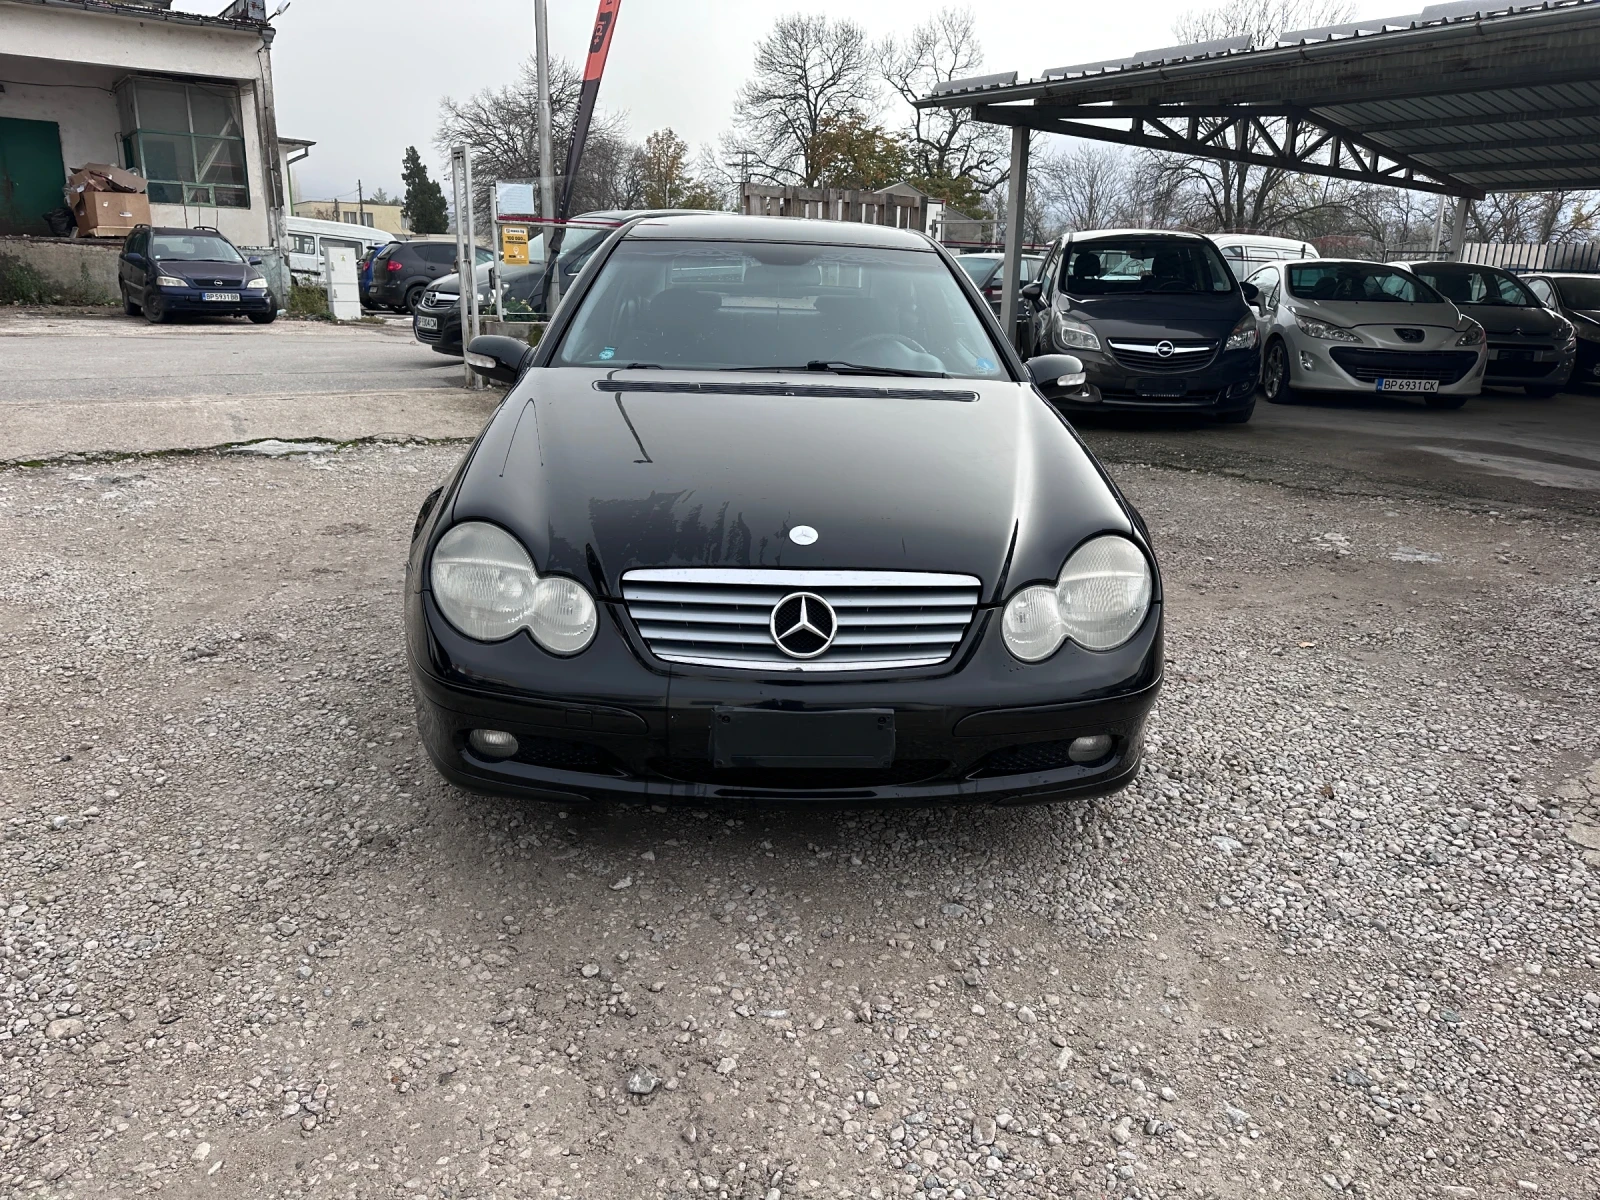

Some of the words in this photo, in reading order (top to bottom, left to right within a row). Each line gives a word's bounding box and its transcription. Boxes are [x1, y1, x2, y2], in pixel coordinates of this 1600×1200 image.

[214, 293, 230, 301] 5931
[1383, 379, 1397, 390] BP
[1398, 380, 1422, 391] 6931
[1423, 381, 1437, 391] CK
